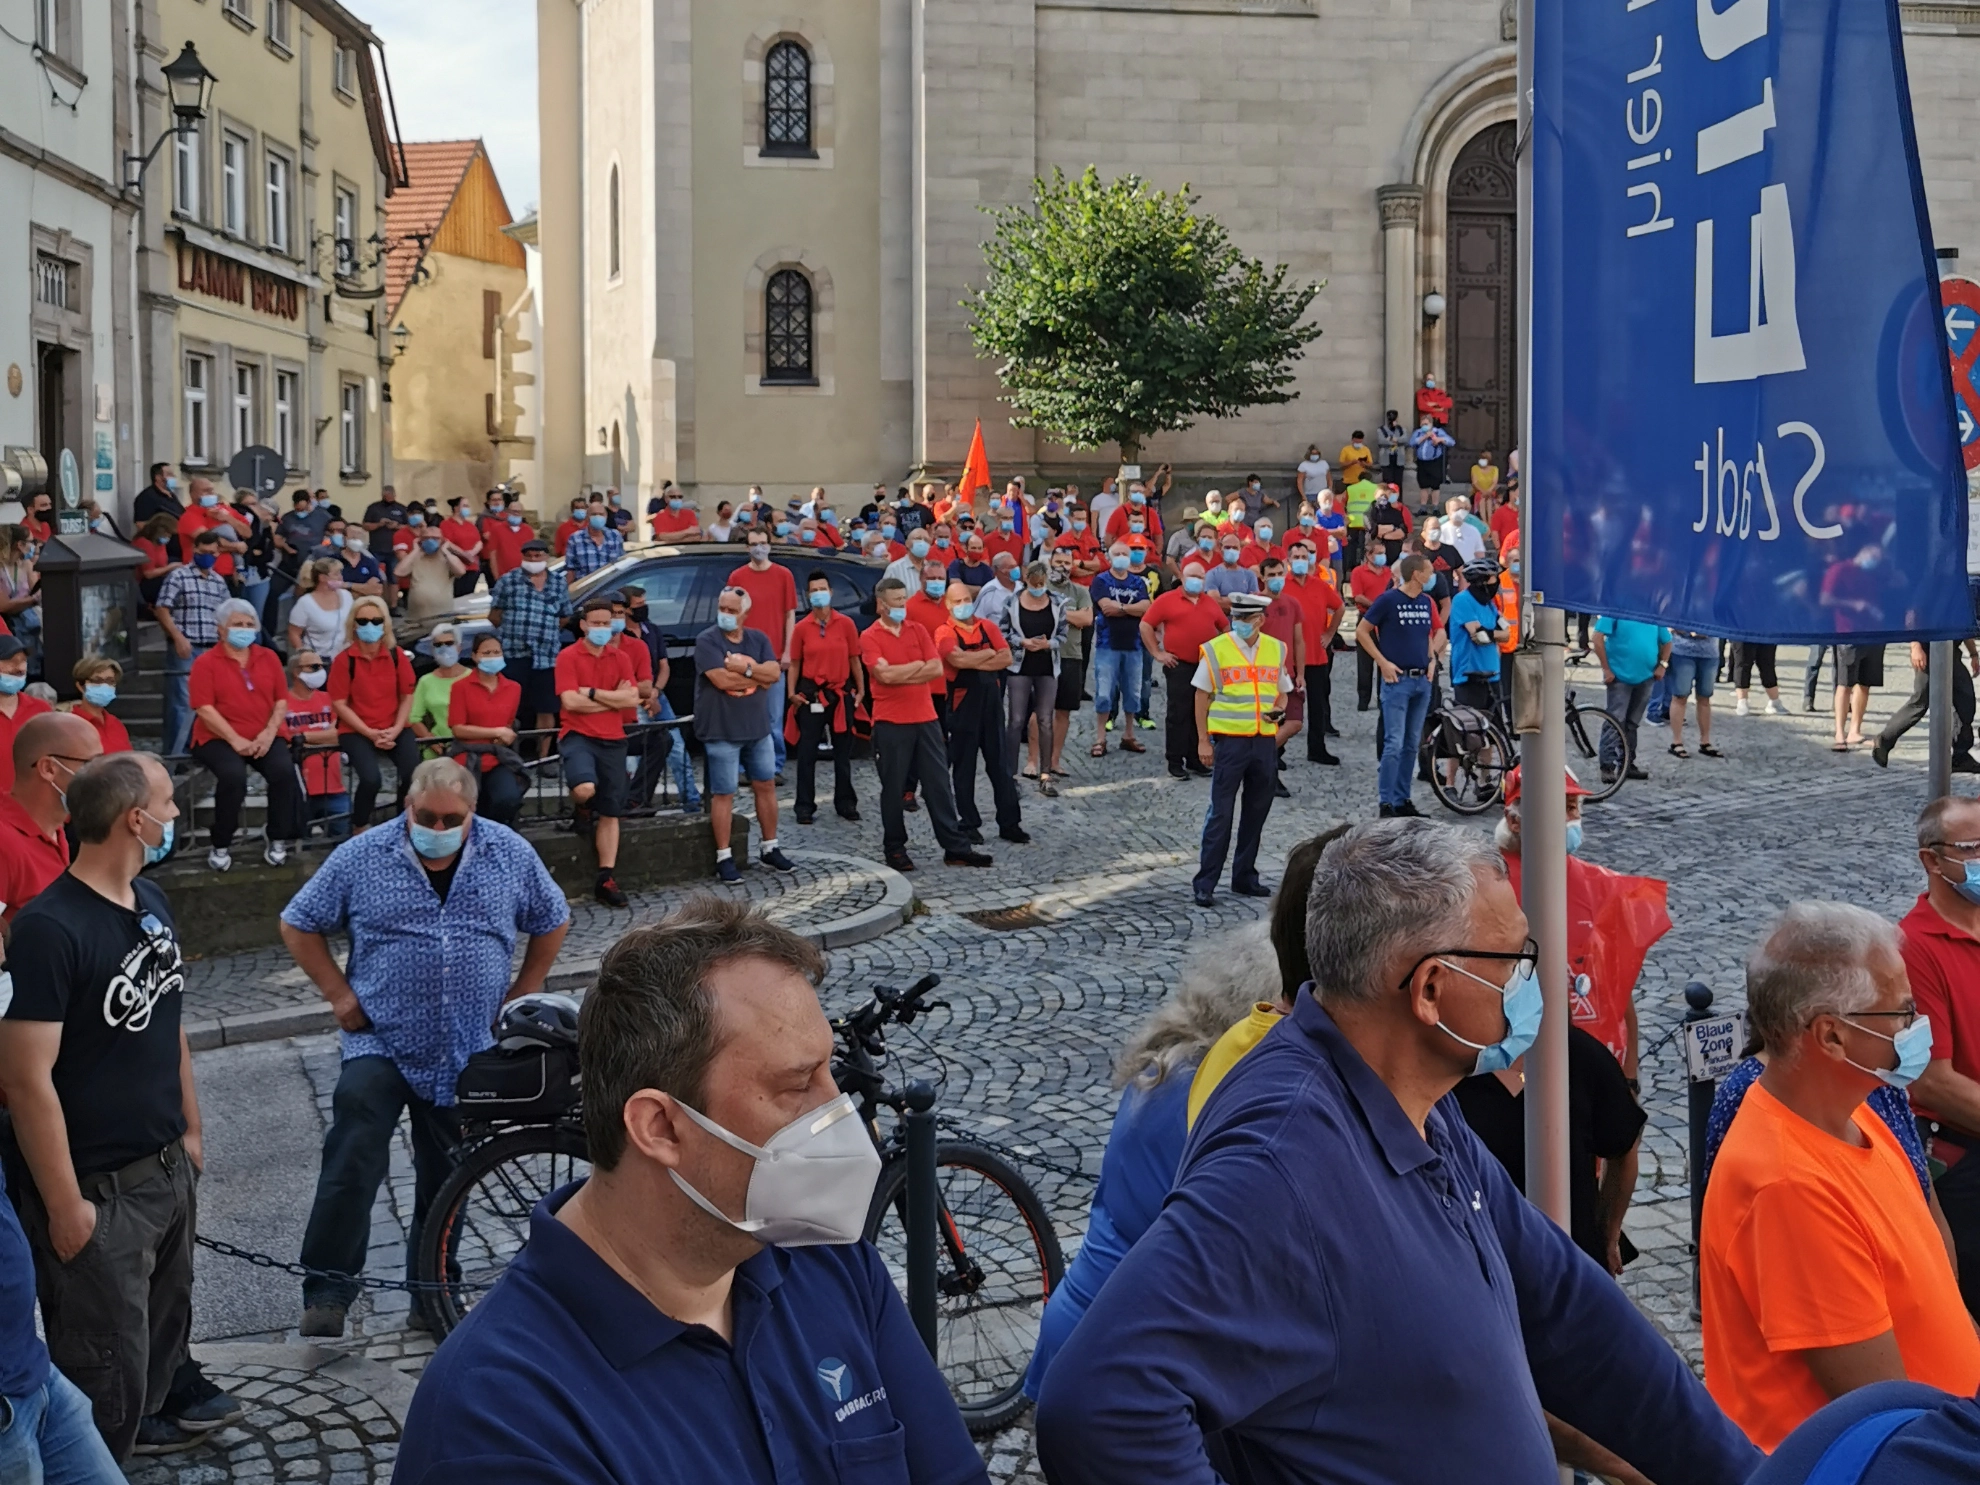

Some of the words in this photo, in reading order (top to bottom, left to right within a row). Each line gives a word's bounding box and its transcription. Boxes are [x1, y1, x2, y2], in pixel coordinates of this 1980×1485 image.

[177, 243, 245, 305] LAMM
[1695, 1021, 1734, 1040] Blaue
[1699, 1036, 1734, 1054] Zone
[1699, 1068, 1706, 1077] 2
